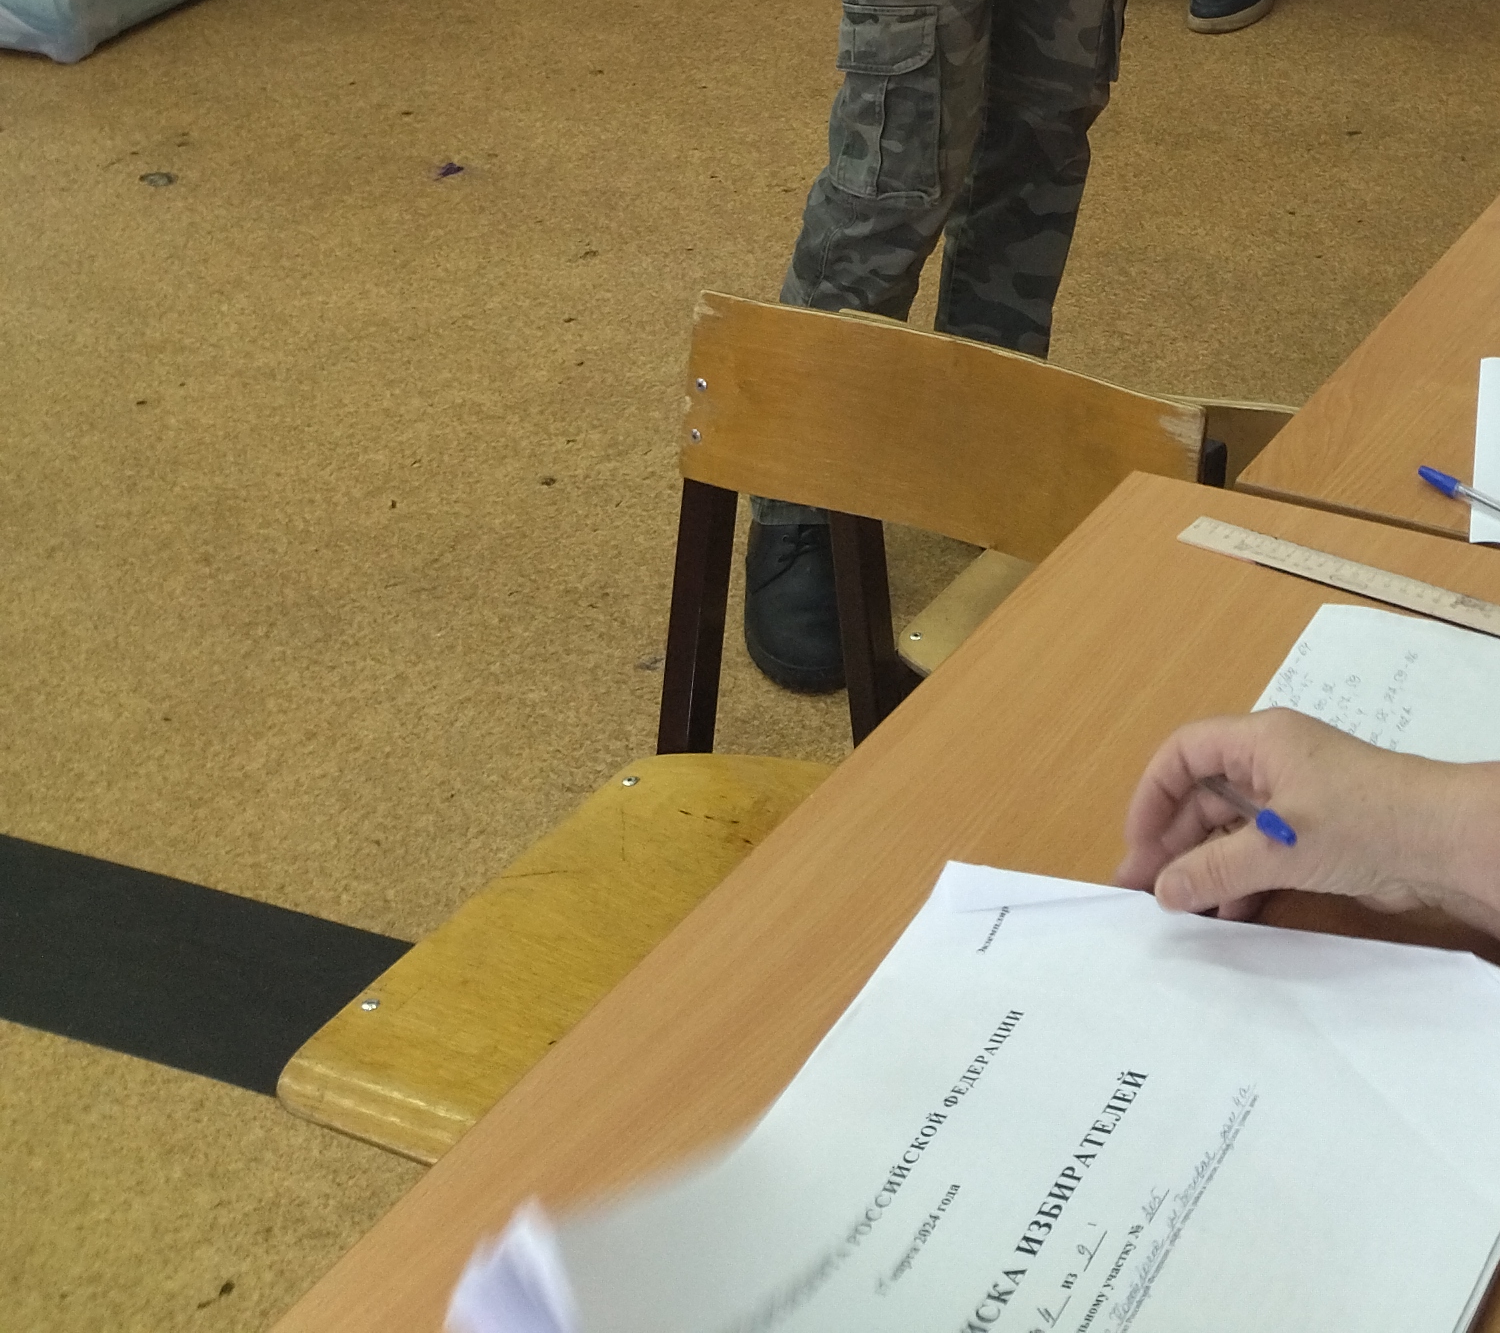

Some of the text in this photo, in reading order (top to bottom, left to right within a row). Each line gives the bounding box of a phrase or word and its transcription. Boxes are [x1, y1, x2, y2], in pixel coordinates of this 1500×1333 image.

[846, 1009, 1025, 1247] РОССИЙСКОЙ ФЕДЕРАЦИИ
[913, 1212, 941, 1244] 2024
[937, 1184, 961, 1212] года
[960, 1069, 1150, 1333] ИСКА ИЗБИРАТЕЛЕЙ
[1061, 1272, 1078, 1290] из
[1103, 1240, 1137, 1289] участку
[1128, 1223, 1144, 1238] №
